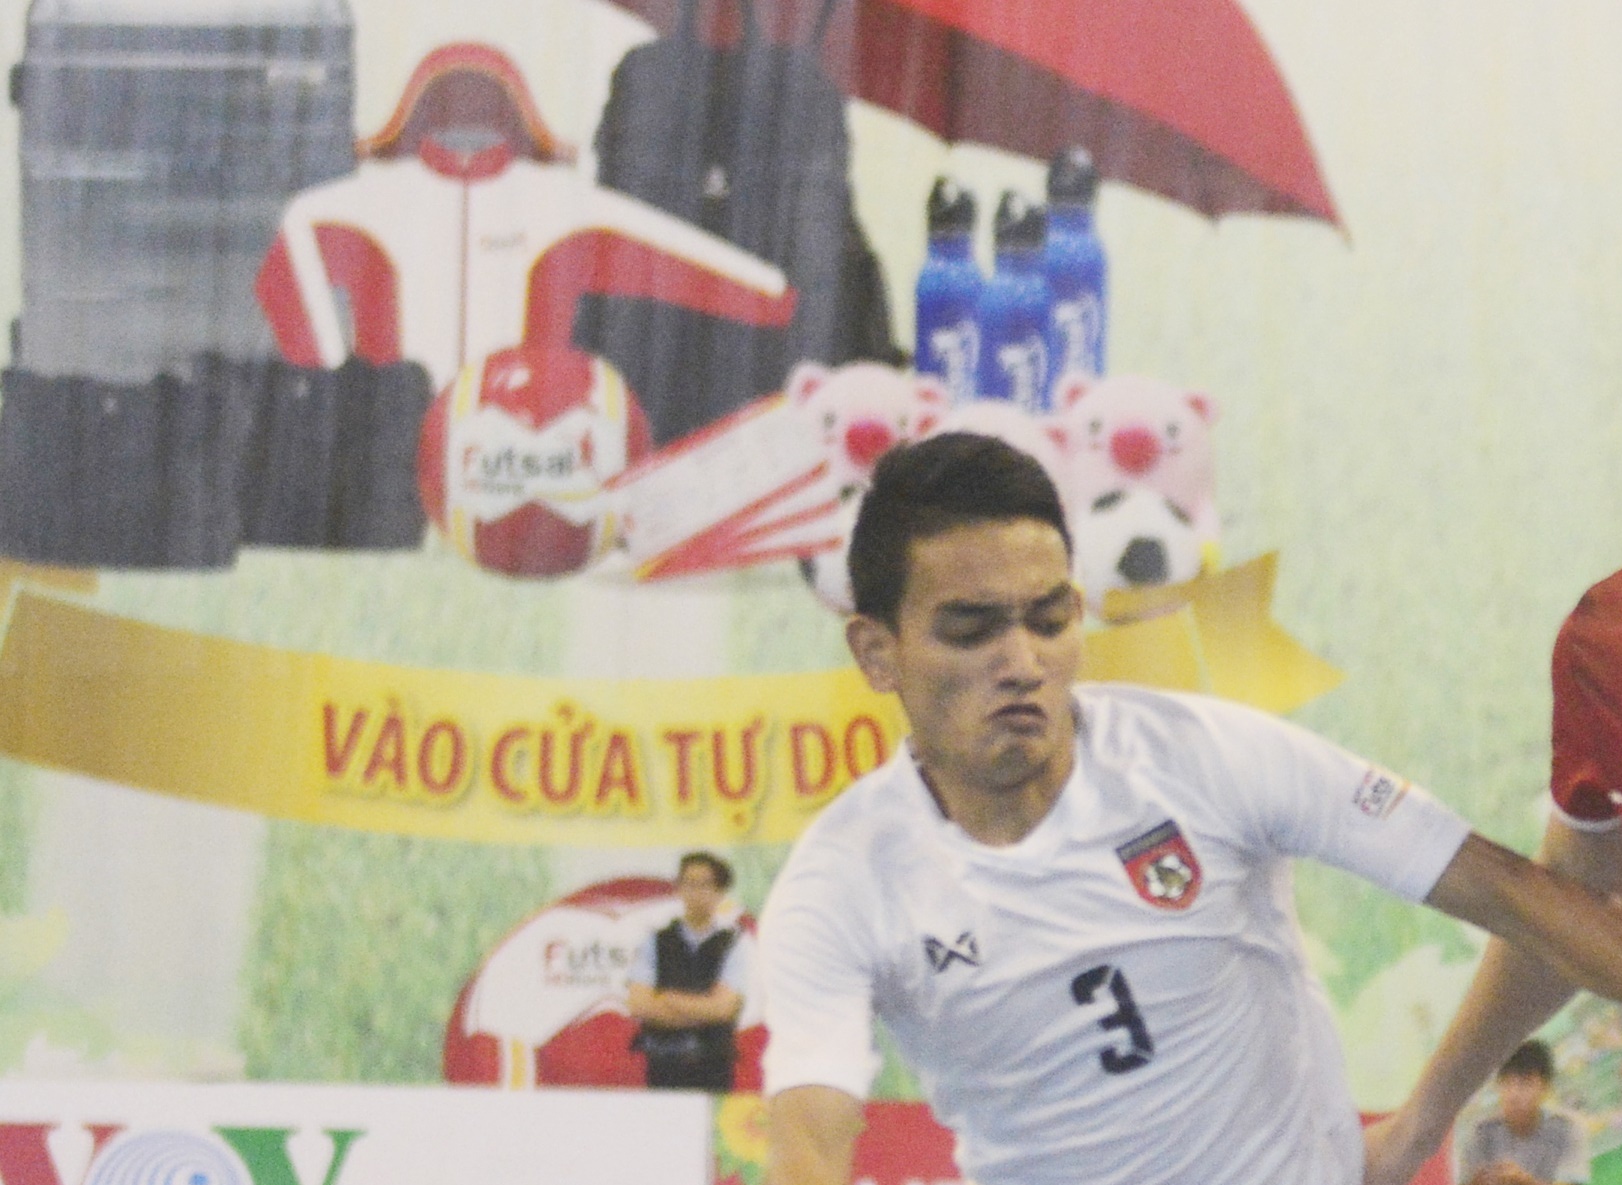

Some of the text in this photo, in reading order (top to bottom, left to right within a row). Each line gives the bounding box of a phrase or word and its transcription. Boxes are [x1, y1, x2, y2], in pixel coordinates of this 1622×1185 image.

[322, 698, 887, 827] VÀO CỬA TỰ DO
[543, 939, 628, 971] Futs
[1070, 964, 1154, 1076] 3
